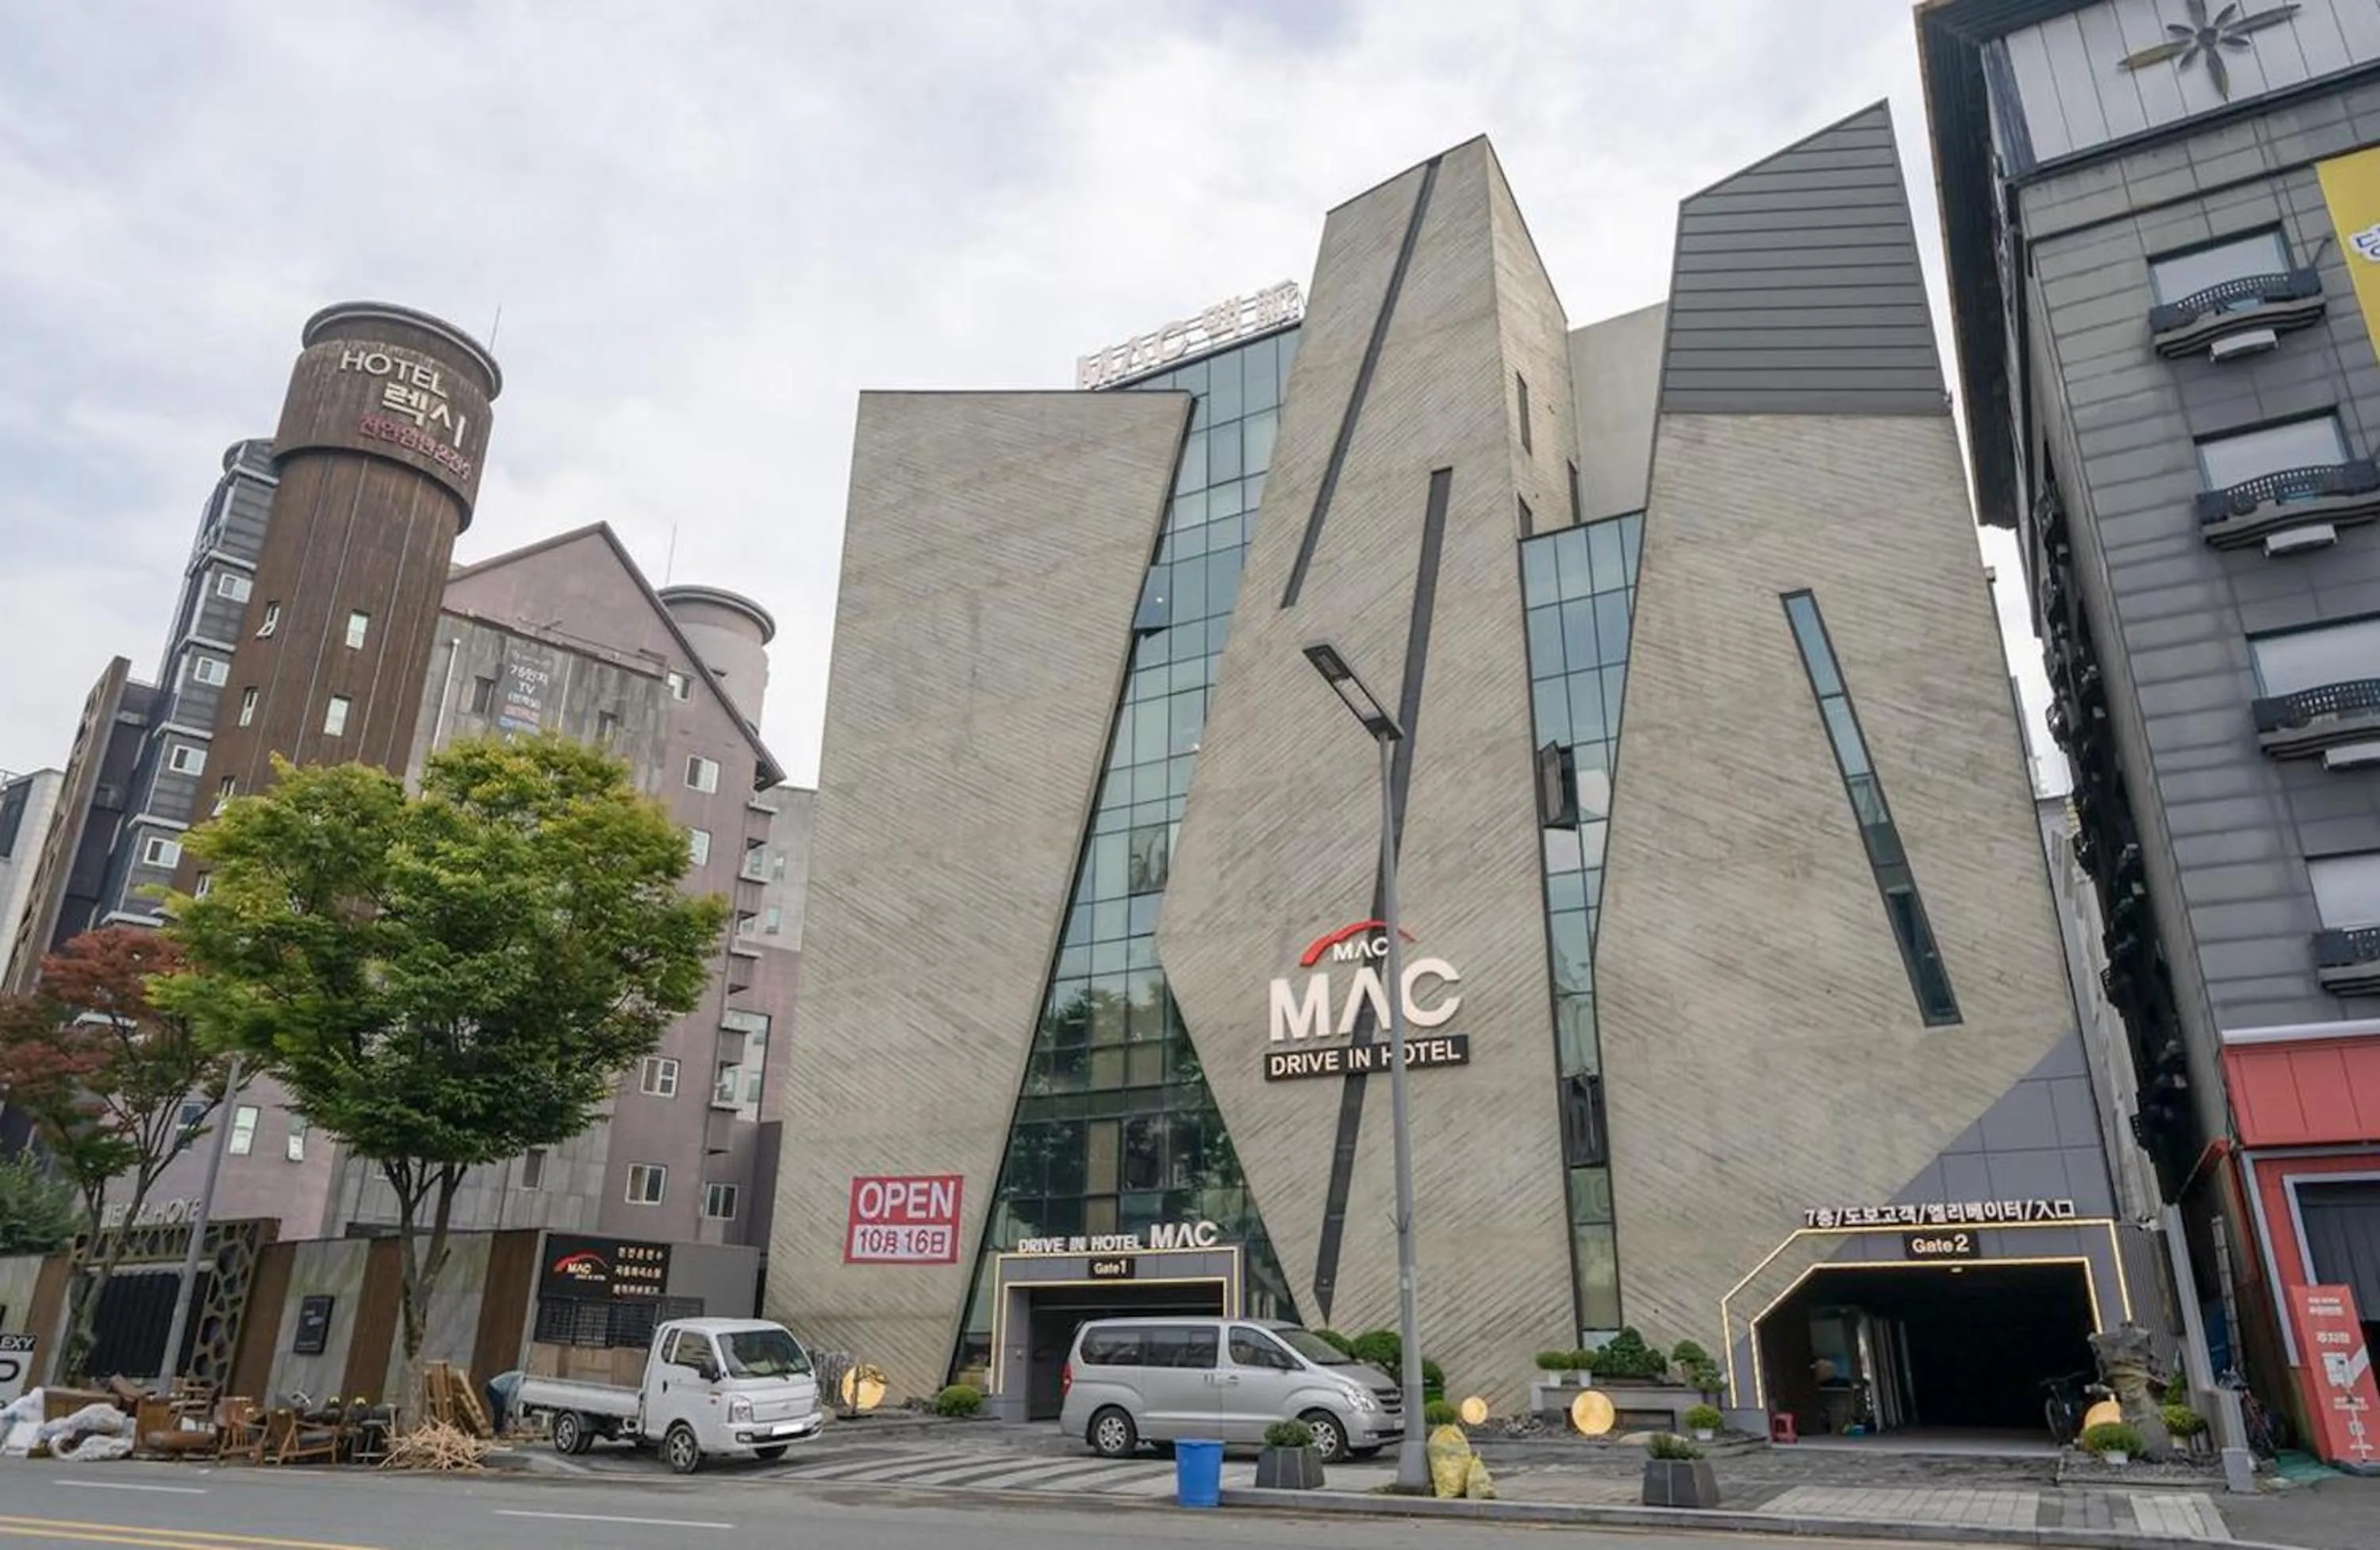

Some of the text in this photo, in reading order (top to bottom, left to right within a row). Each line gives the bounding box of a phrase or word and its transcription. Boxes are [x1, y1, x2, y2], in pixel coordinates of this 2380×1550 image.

[1077, 320, 1189, 389] MAC
[340, 351, 448, 399] HOTEL
[382, 382, 466, 448] 렉시
[518, 681, 536, 694] TV
[1333, 936, 1389, 962] MAC
[1269, 957, 1461, 1042] MAC
[1271, 1040, 1461, 1076] DRIVE IN HOTEL
[154, 1197, 204, 1223] HOTE
[858, 1180, 955, 1220] OPEN
[905, 1229, 946, 1254] 16日
[1018, 1221, 1219, 1253] DRIVE IN HOTEL MAC
